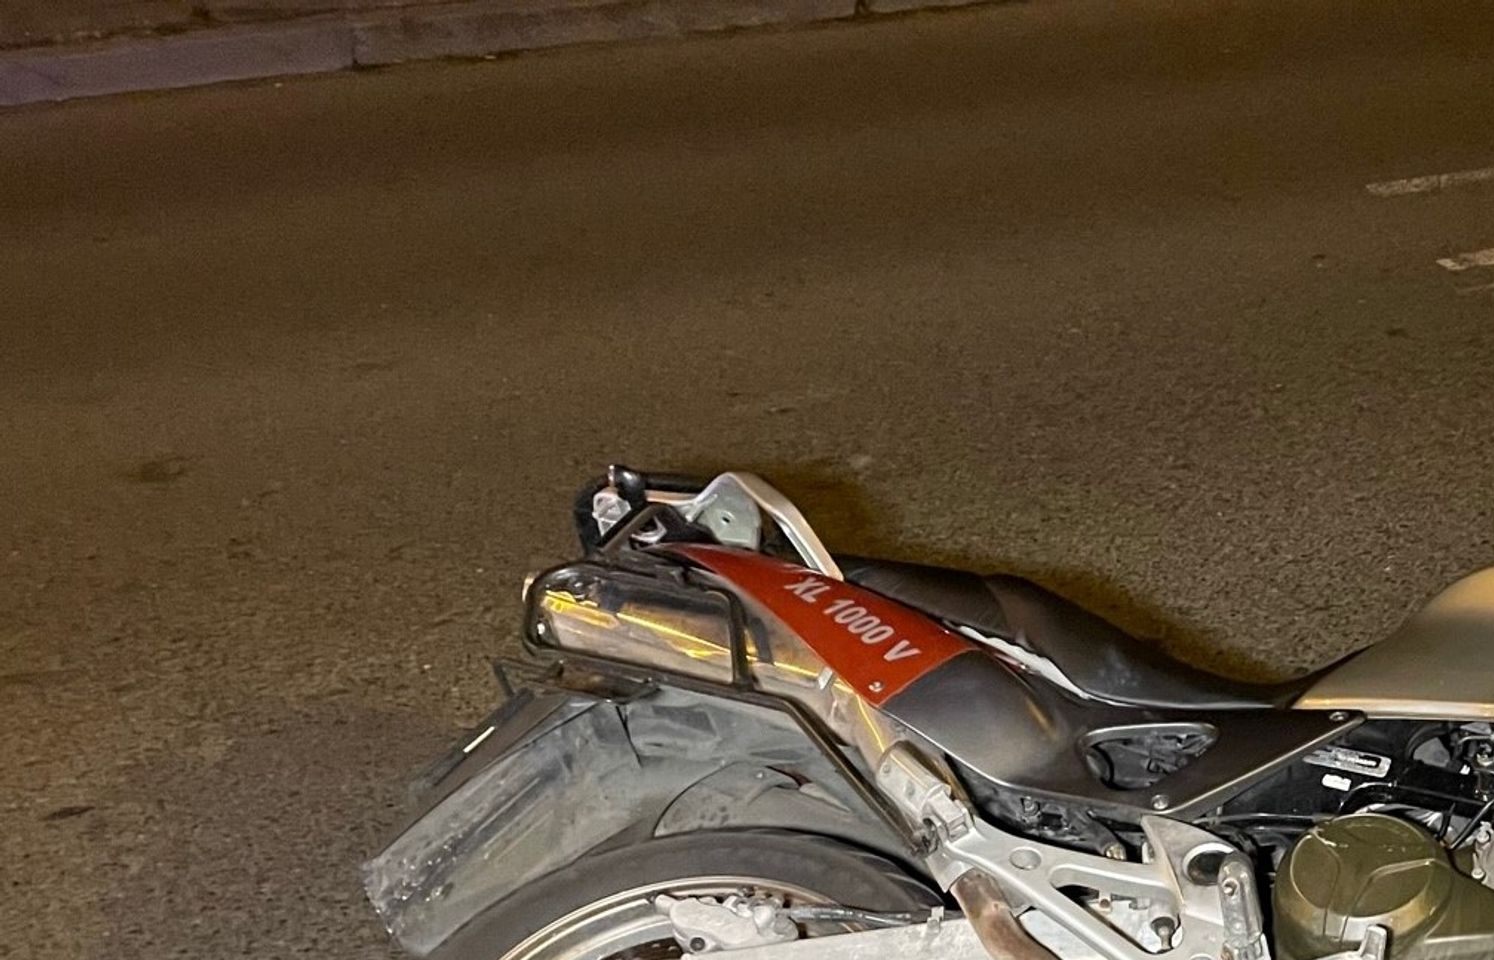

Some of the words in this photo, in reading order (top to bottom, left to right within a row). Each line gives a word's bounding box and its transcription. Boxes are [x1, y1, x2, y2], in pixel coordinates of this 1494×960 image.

[784, 577, 831, 603] XL
[823, 599, 895, 644] 1000
[883, 640, 921, 662] V
